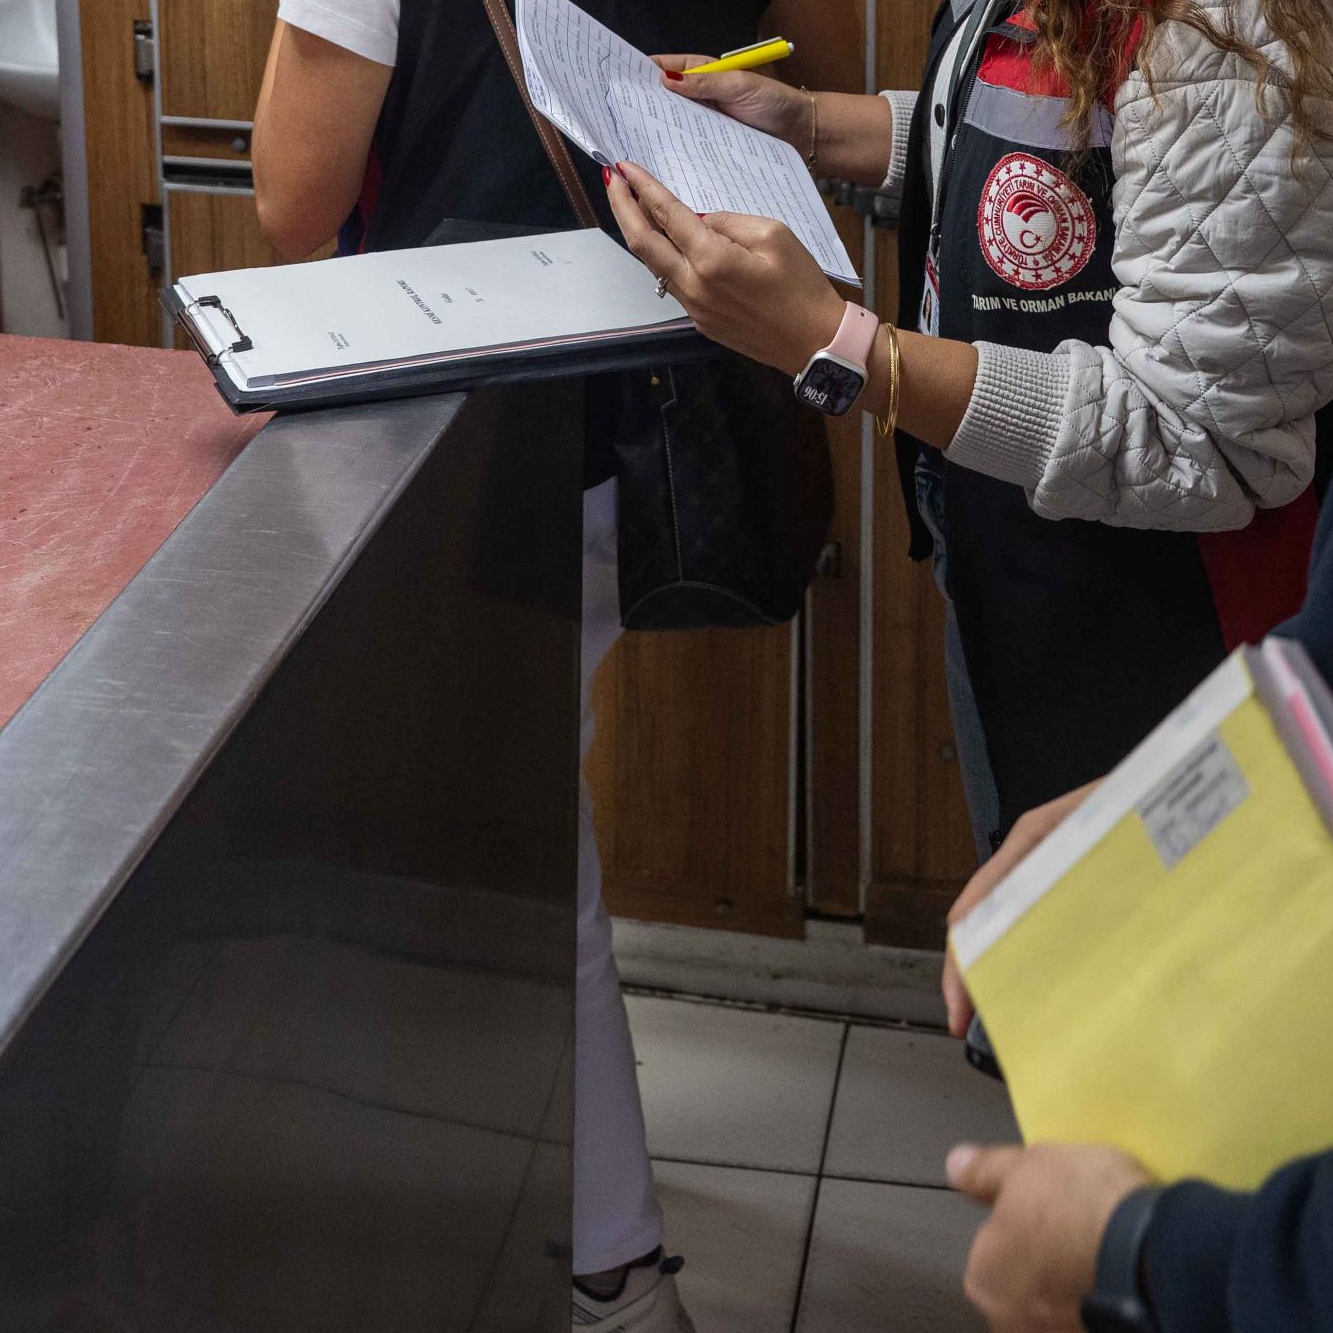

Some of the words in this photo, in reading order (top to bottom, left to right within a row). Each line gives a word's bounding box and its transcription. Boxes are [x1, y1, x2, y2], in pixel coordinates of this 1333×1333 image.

[971, 294, 1002, 311] TARIM
[1002, 297, 1019, 311] VE
[1019, 295, 1066, 313] ORMAN
[1067, 286, 1118, 304] BAKAN
[803, 386, 828, 406] 15:06
